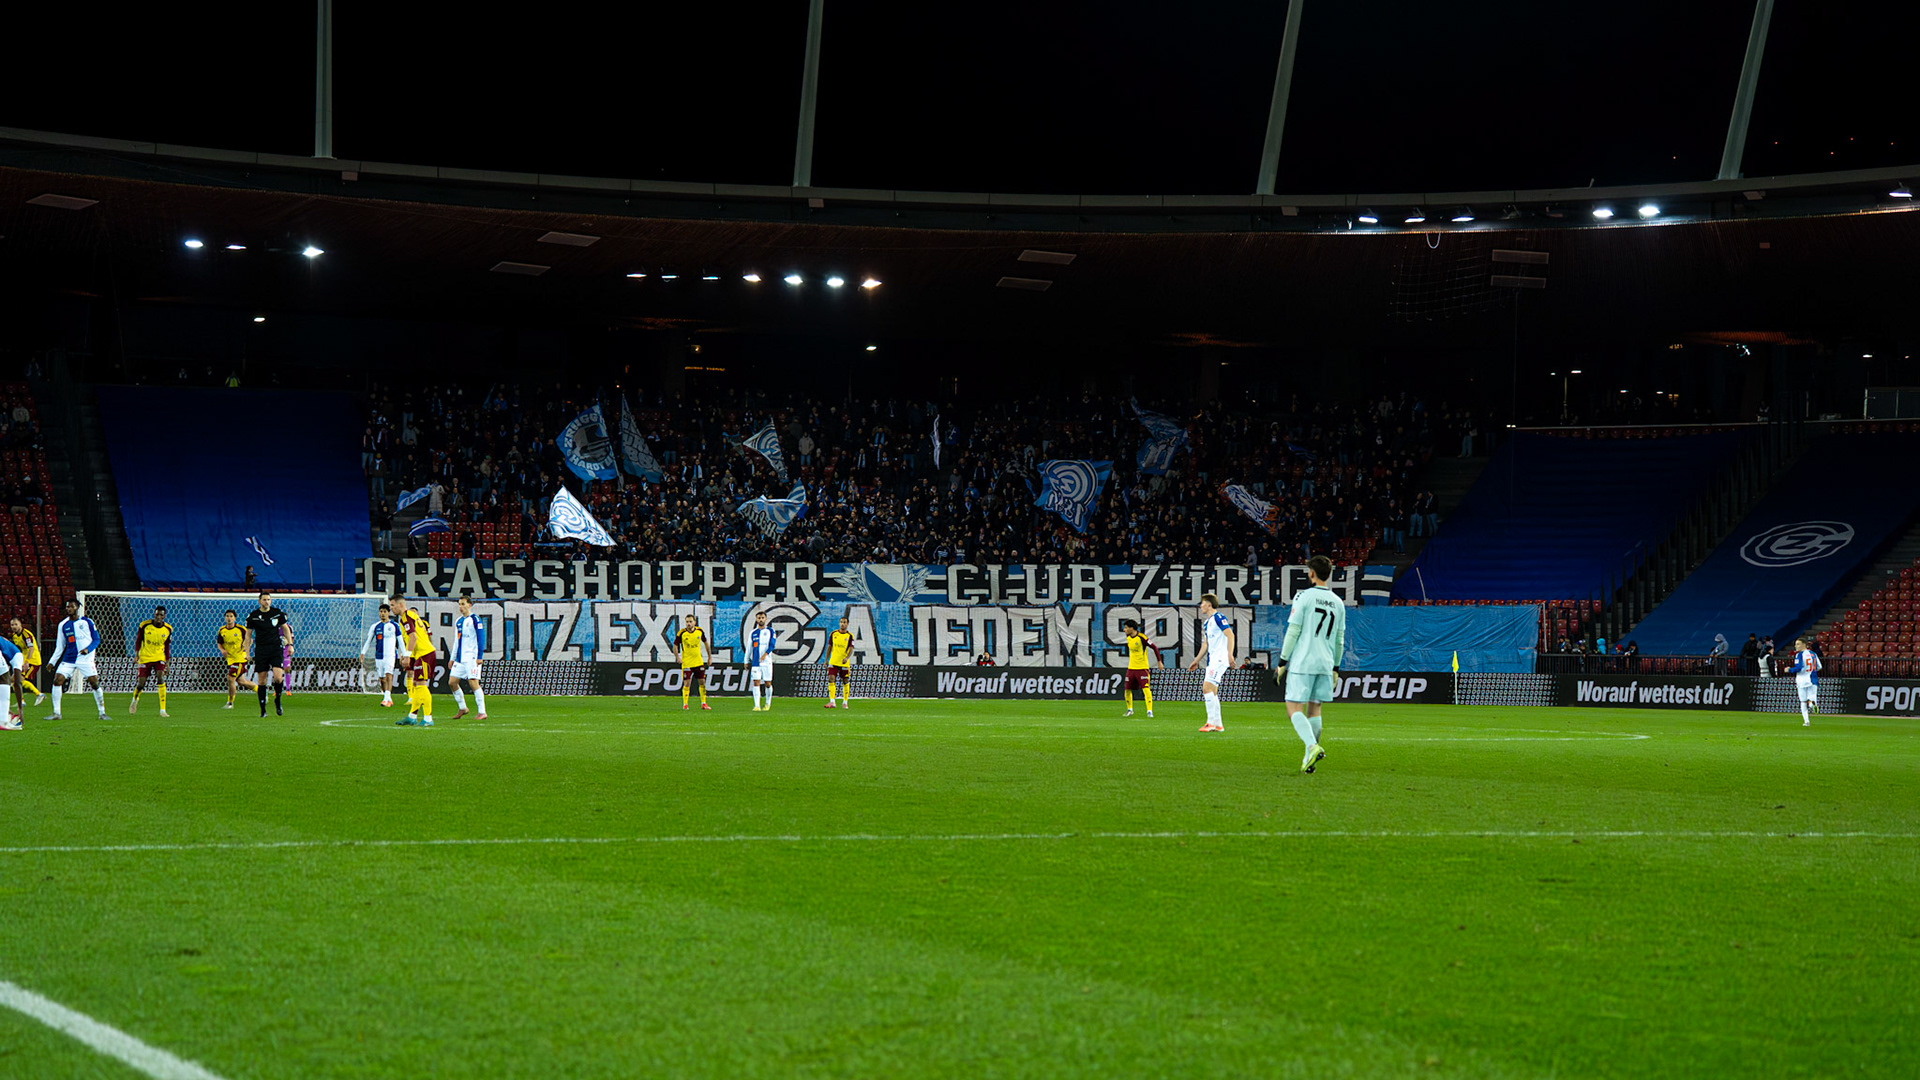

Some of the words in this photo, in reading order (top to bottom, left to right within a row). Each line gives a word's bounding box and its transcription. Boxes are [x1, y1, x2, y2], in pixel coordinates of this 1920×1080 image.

[364, 557, 821, 602] GRASSHOPPER
[947, 563, 1104, 605] CLUB
[1132, 564, 1359, 605] ZÜRICH
[897, 605, 1093, 667] JEDEM
[1315, 608, 1335, 640] 71
[317, 667, 401, 688] wettet
[938, 672, 1008, 694] Worauf
[1010, 675, 1083, 694] wettest
[1086, 673, 1122, 695] du?
[1577, 680, 1638, 703] Worauf
[1639, 684, 1702, 704] wettest
[1703, 682, 1734, 705] du?
